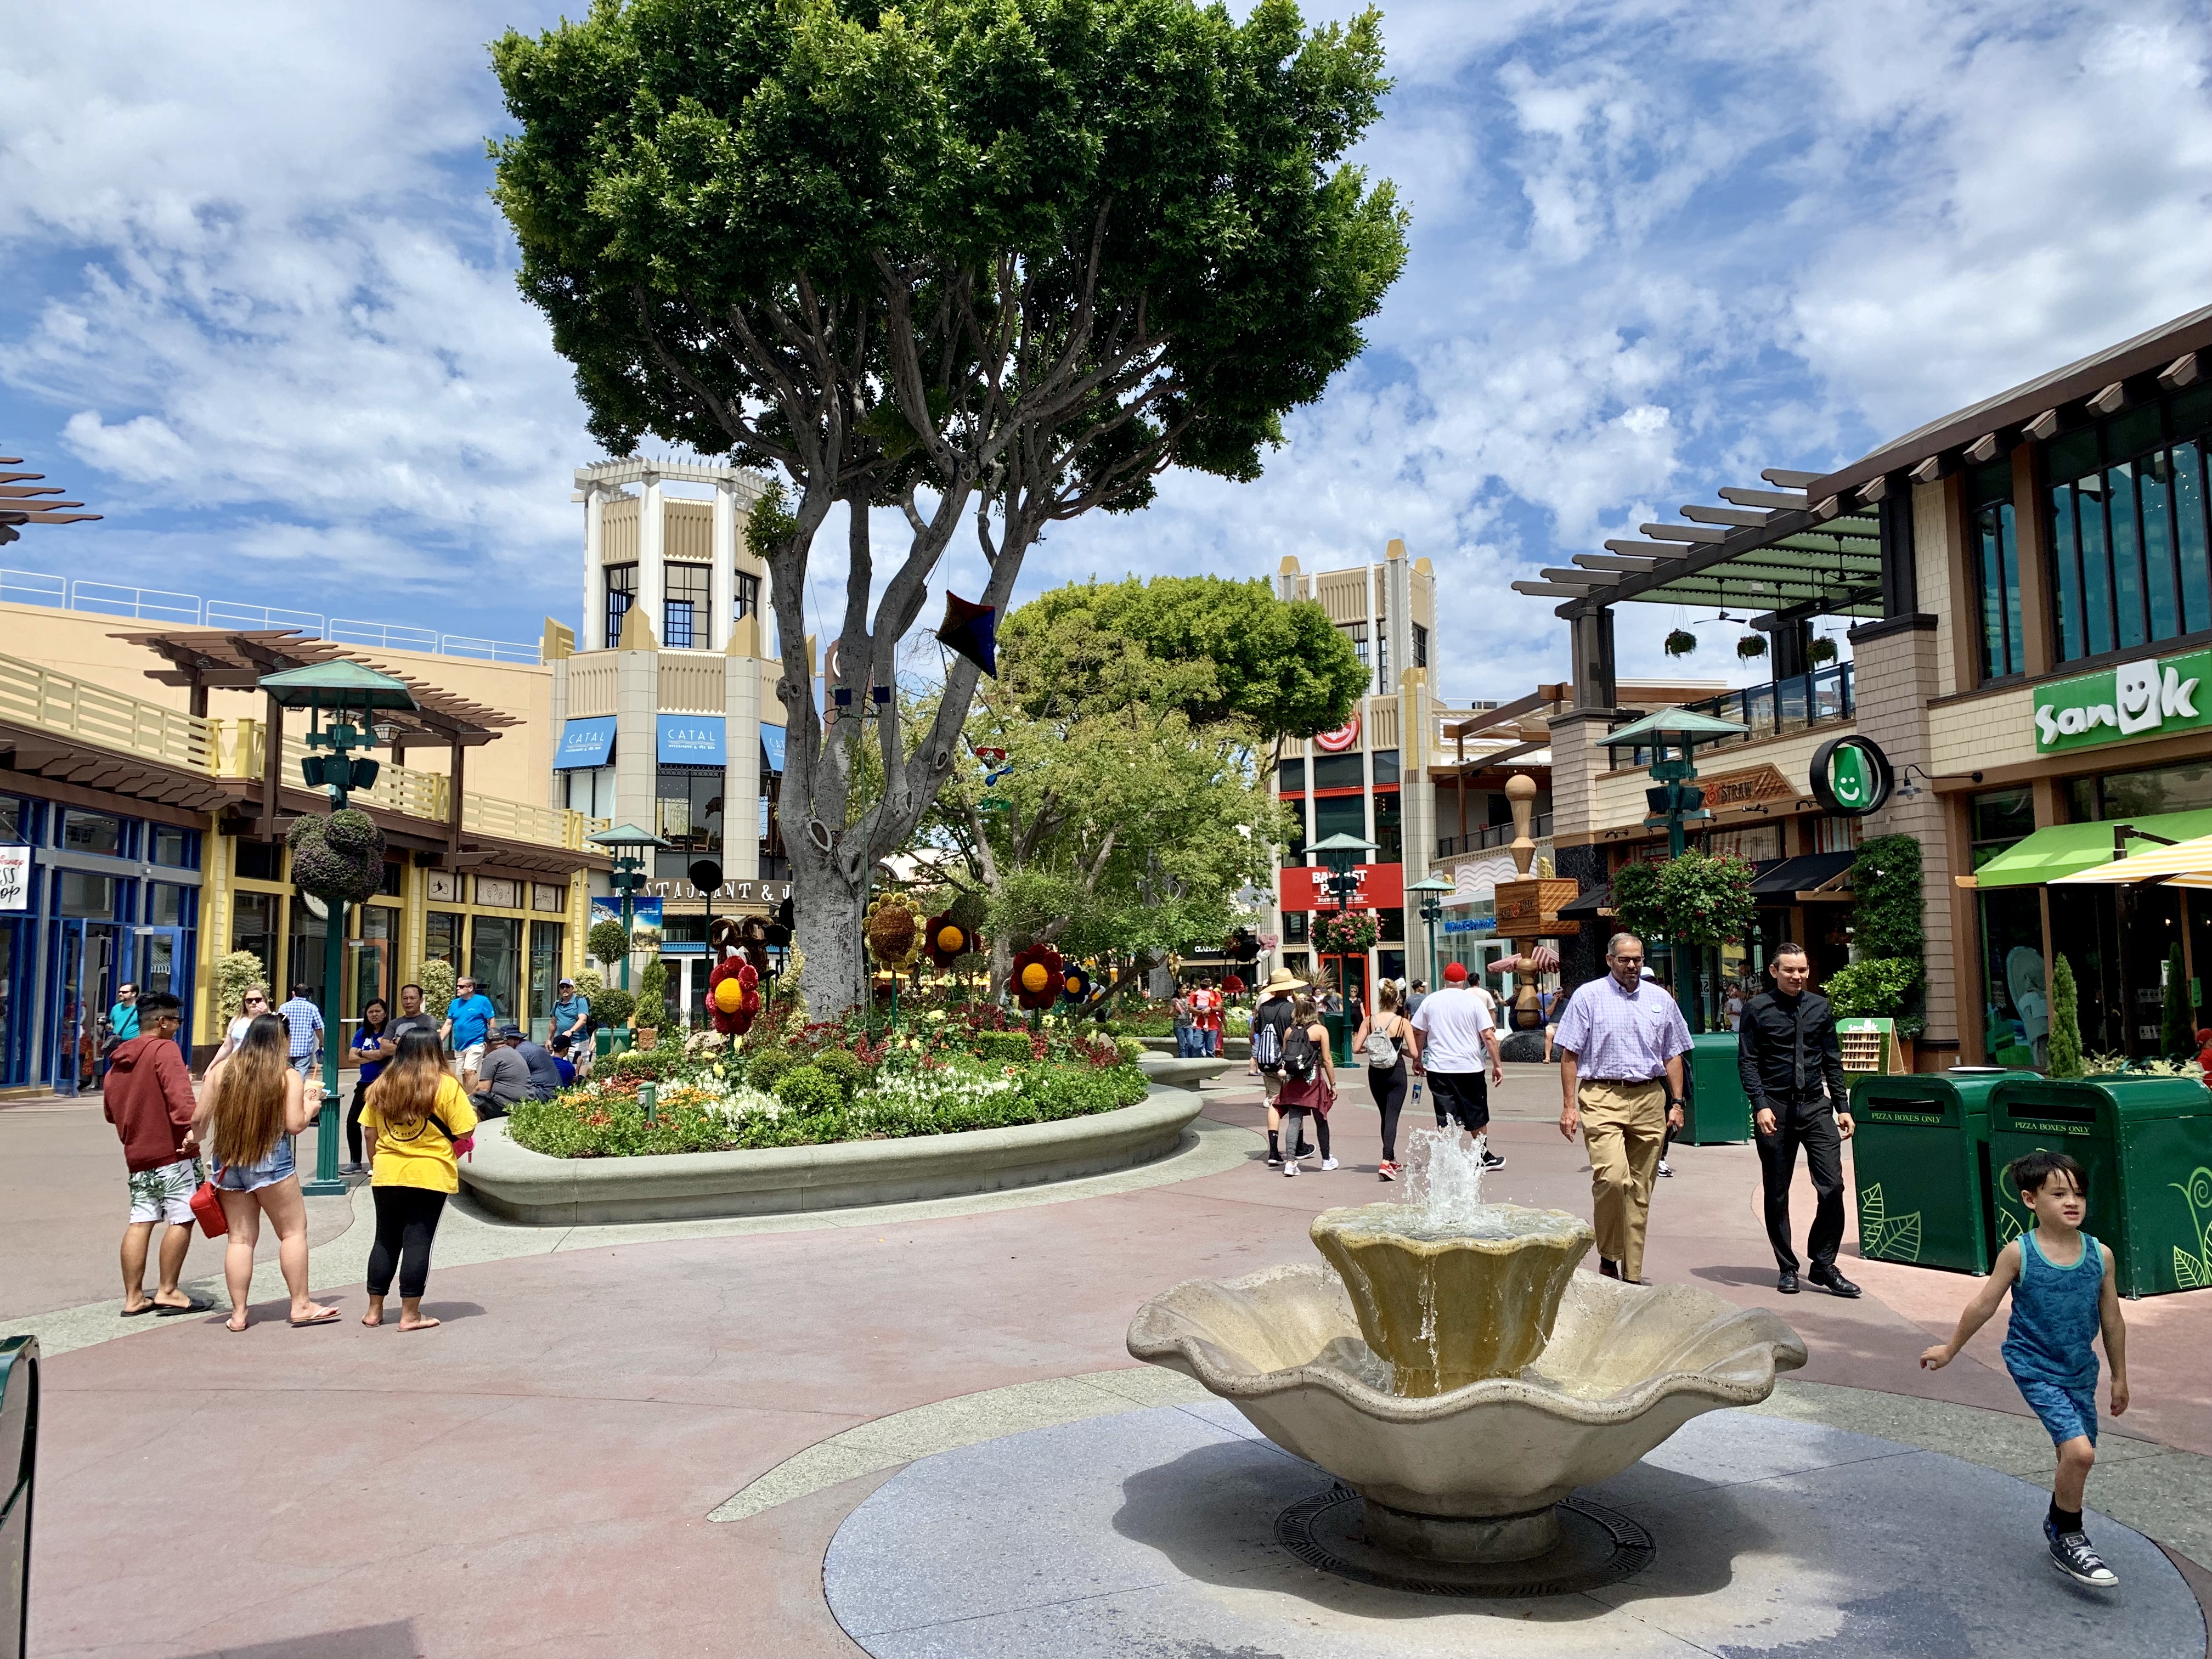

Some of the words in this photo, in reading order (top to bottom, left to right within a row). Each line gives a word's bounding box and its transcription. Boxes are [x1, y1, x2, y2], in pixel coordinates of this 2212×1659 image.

[568, 731, 604, 744] CATAL
[668, 729, 715, 741] CATAL
[769, 738, 785, 748] CAT
[761, 884, 774, 901] &
[1844, 1033, 1863, 1041] COME
[1894, 1114, 1919, 1122] BOXES
[2015, 1121, 2037, 1130] PIZZA
[2040, 1123, 2066, 1132] BOXES
